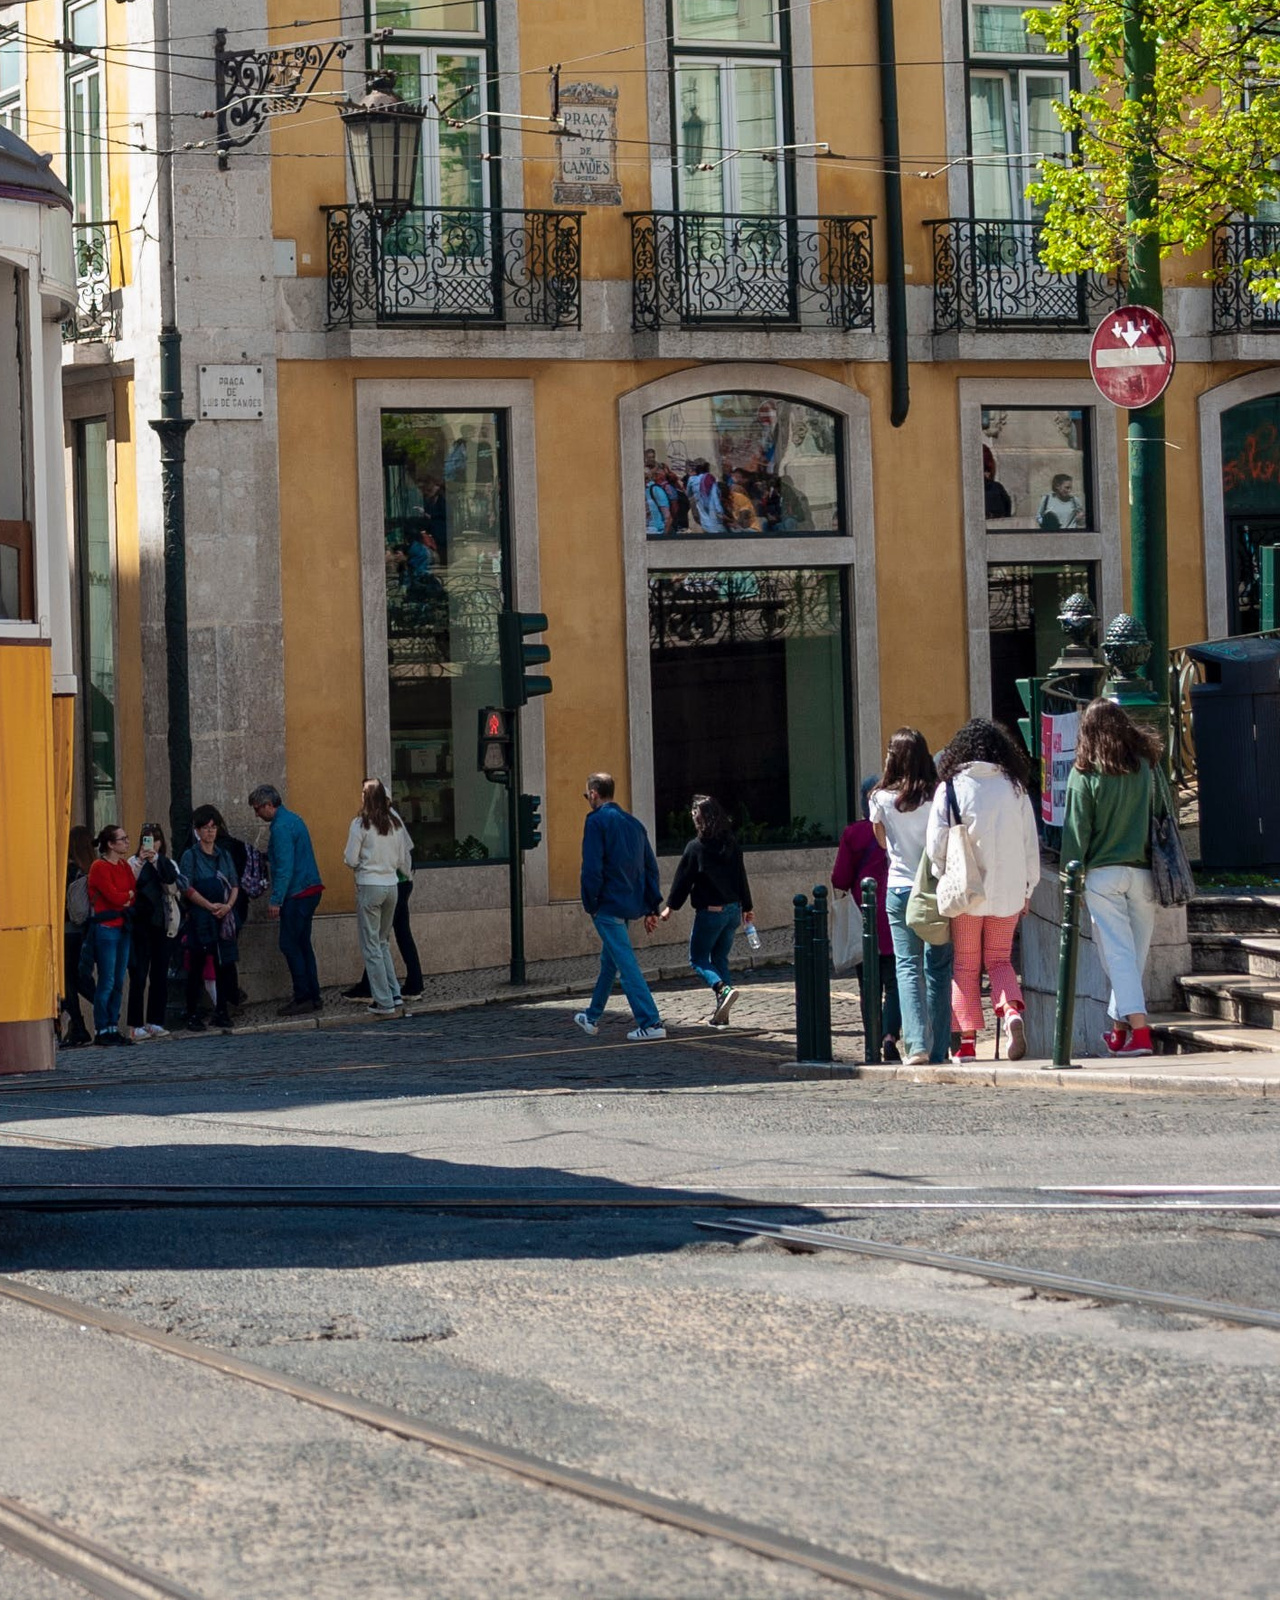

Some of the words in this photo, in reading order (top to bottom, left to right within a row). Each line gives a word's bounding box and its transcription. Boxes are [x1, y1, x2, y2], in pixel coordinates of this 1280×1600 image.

[564, 112, 608, 126] PRAÇA
[580, 147, 592, 155] DE
[226, 388, 237, 397] DE
